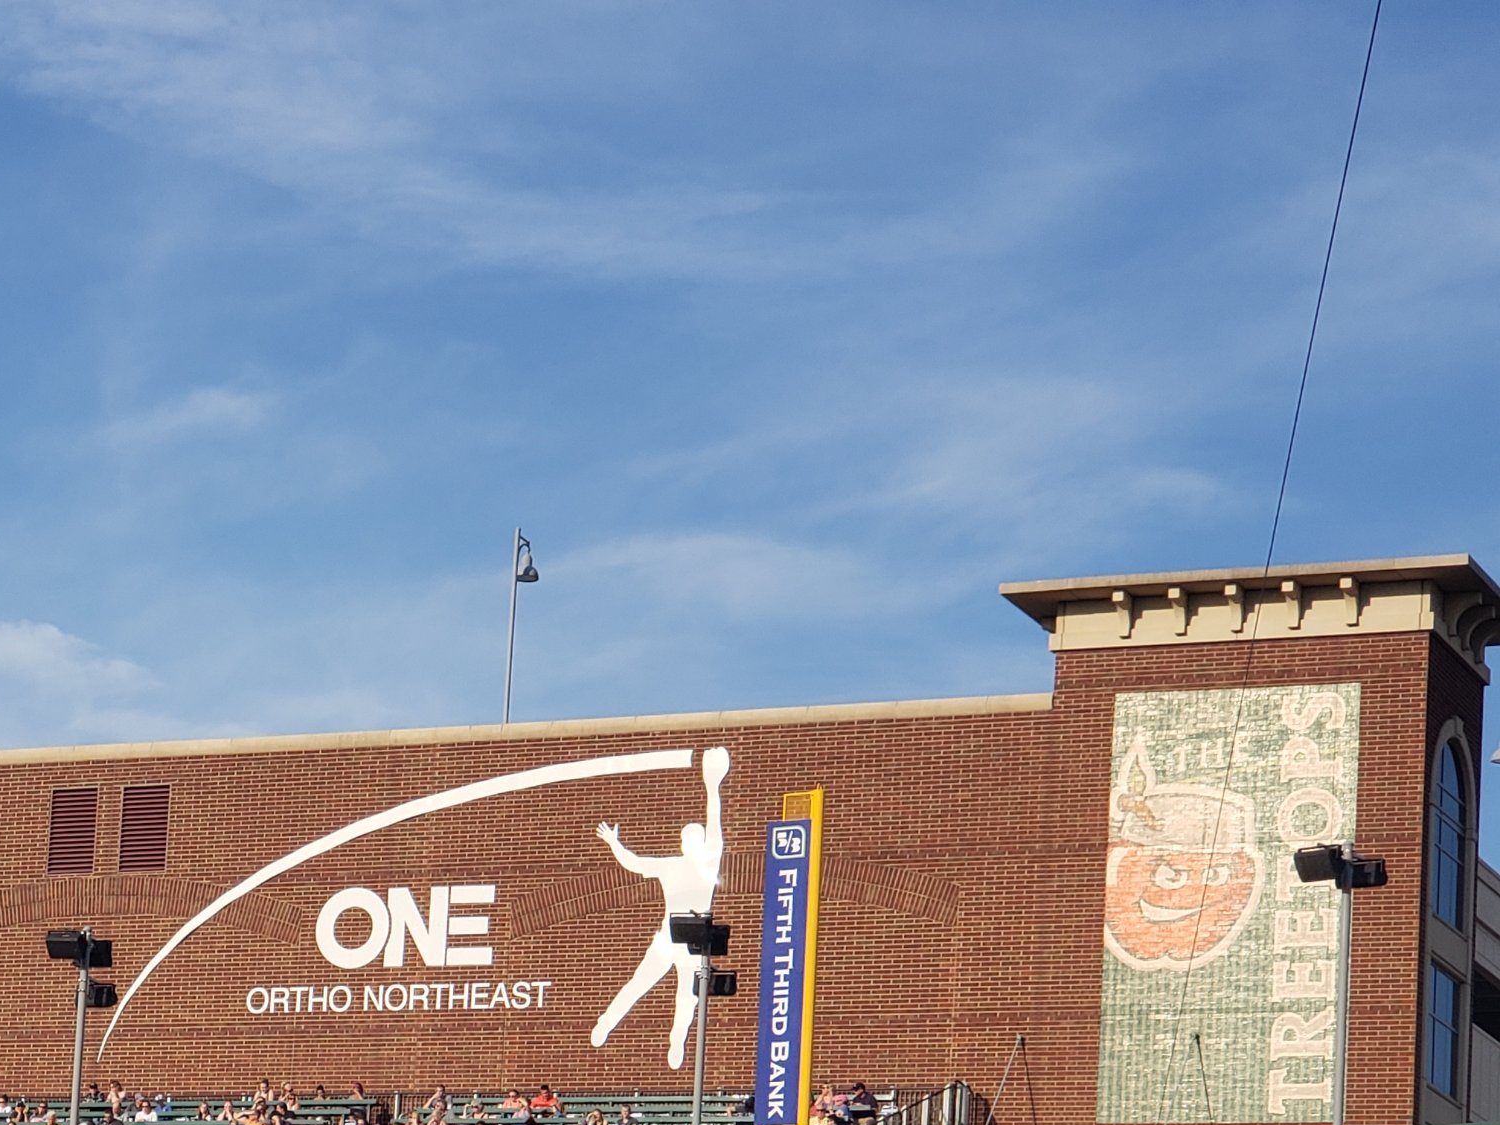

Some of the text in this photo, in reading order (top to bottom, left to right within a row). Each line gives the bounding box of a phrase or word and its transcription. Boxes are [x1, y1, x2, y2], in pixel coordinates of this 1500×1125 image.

[315, 884, 497, 969] ONE
[246, 981, 552, 1014] ORTHO NORTHEAST
[766, 867, 798, 1120] FIFTH THIRD BANK
